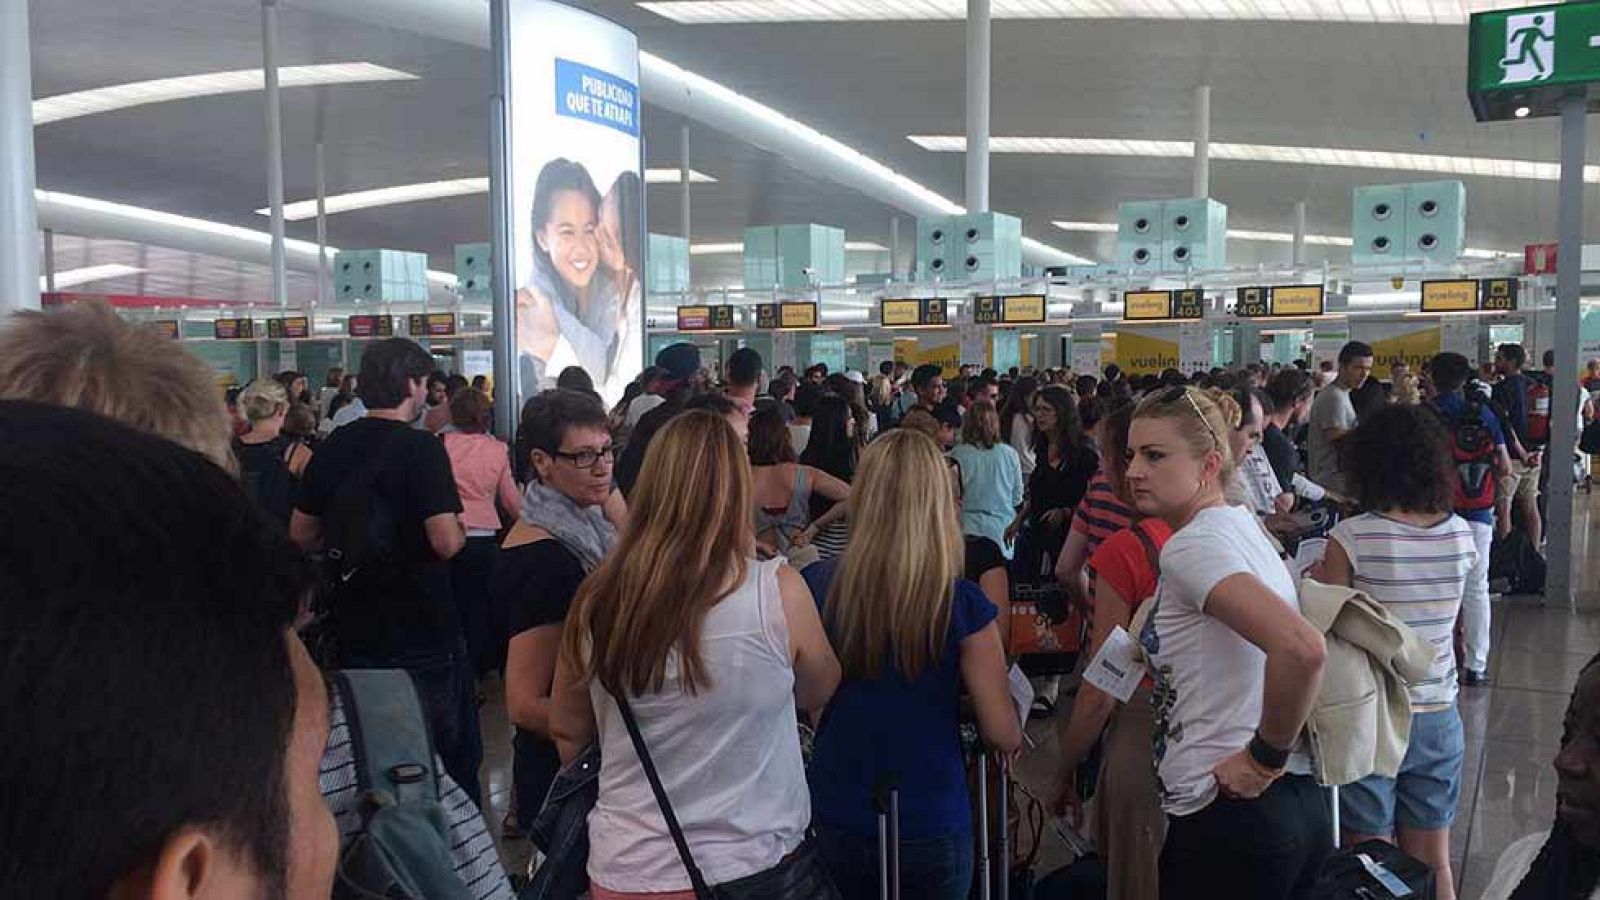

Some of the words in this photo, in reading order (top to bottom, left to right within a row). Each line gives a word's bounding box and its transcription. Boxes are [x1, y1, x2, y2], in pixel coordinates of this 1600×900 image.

[566, 92, 590, 114] QUE
[591, 97, 604, 118] TE
[1239, 303, 1264, 315] 402
[1486, 297, 1512, 309] 401
[1176, 305, 1200, 316] 403
